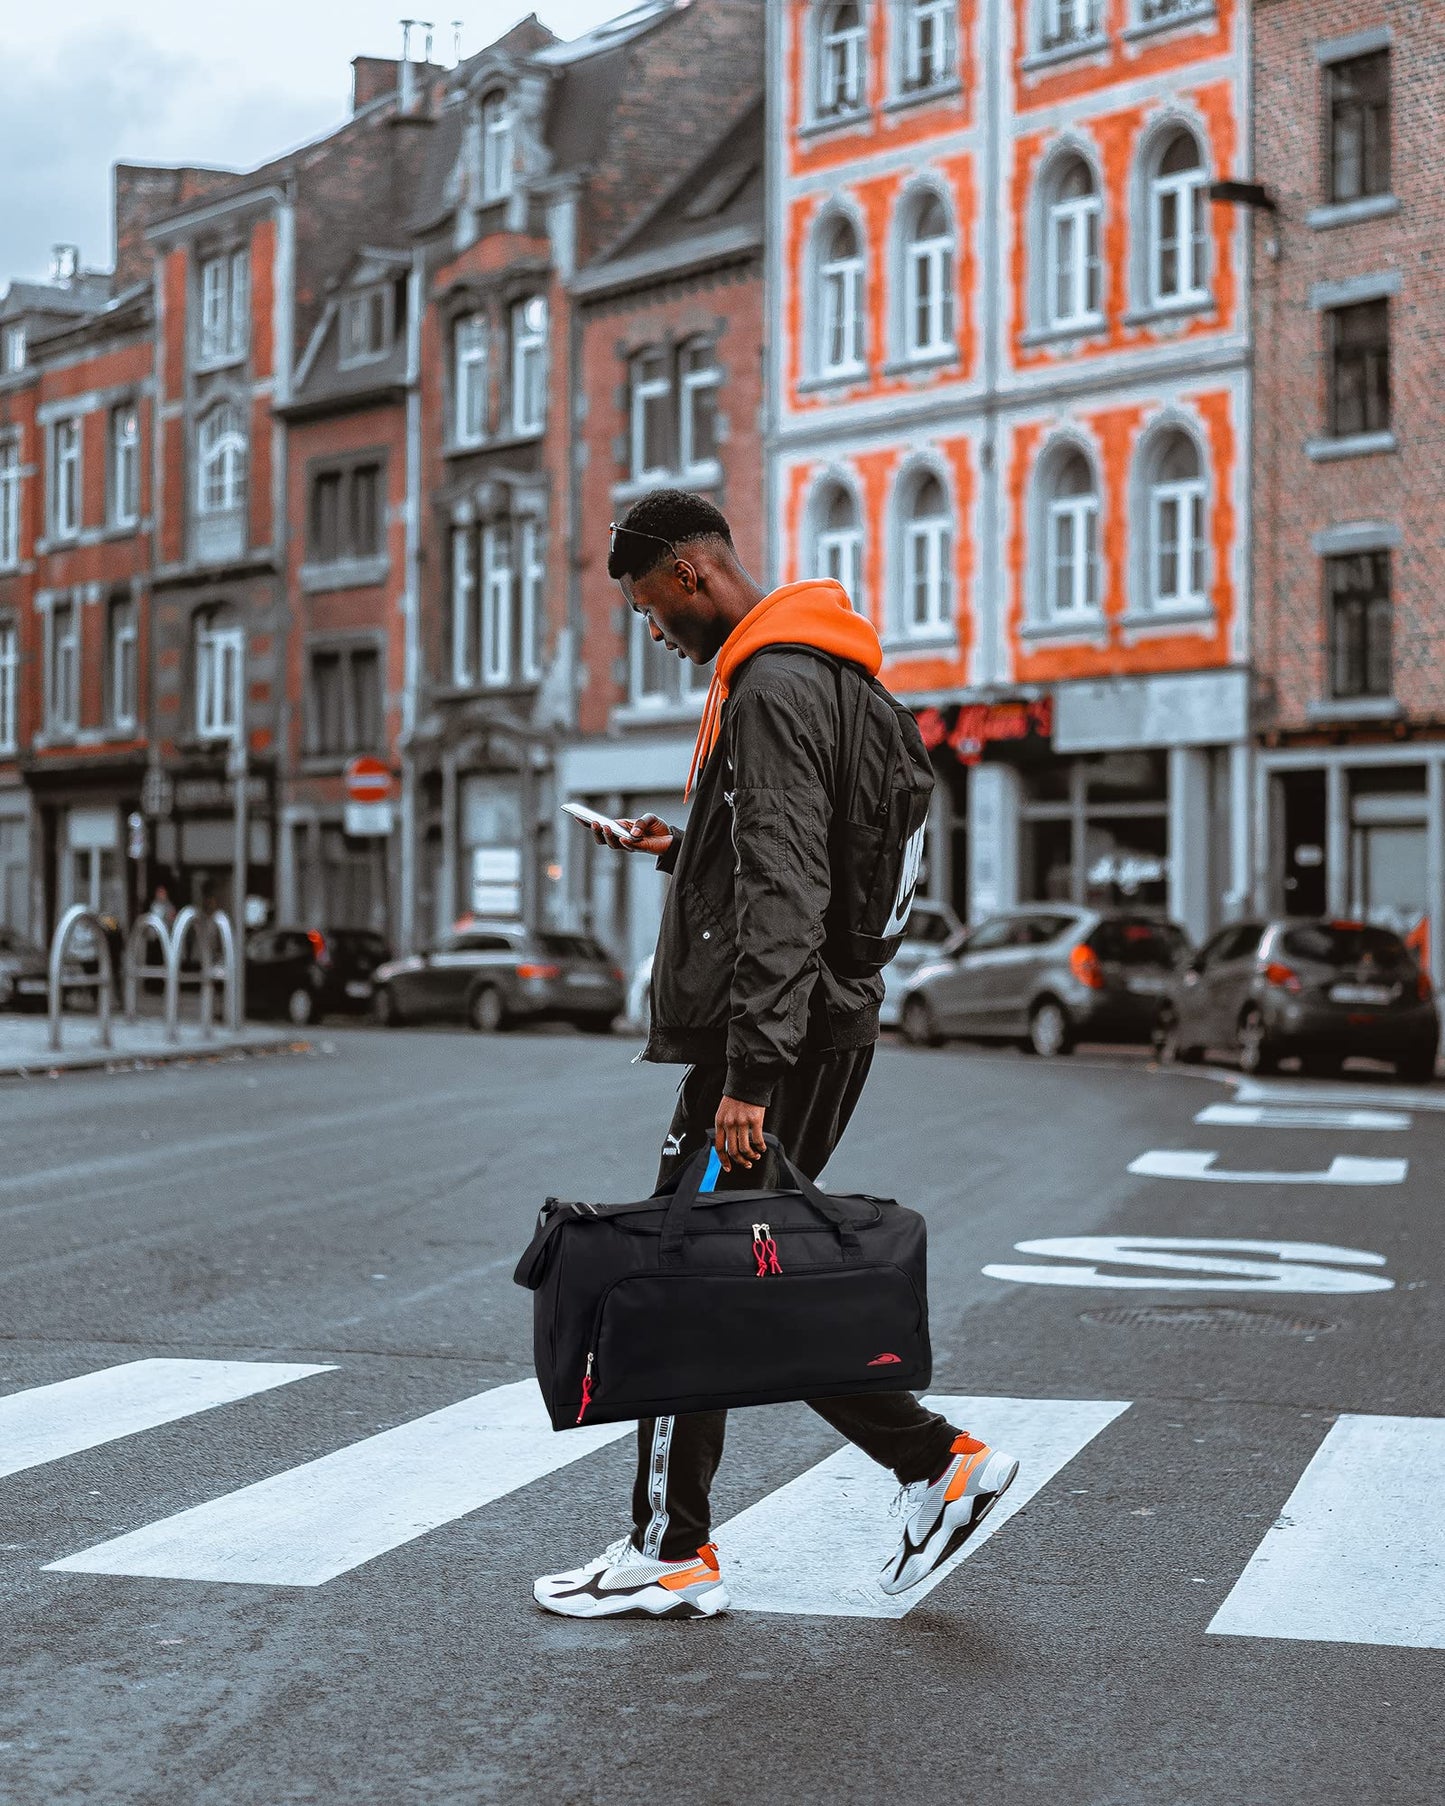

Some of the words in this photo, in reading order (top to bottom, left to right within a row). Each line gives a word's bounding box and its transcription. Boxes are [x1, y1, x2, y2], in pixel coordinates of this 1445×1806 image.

[659, 1416, 669, 1438] UMA
[655, 1454, 665, 1474] PUMA
[649, 1522, 662, 1546] PUMA
